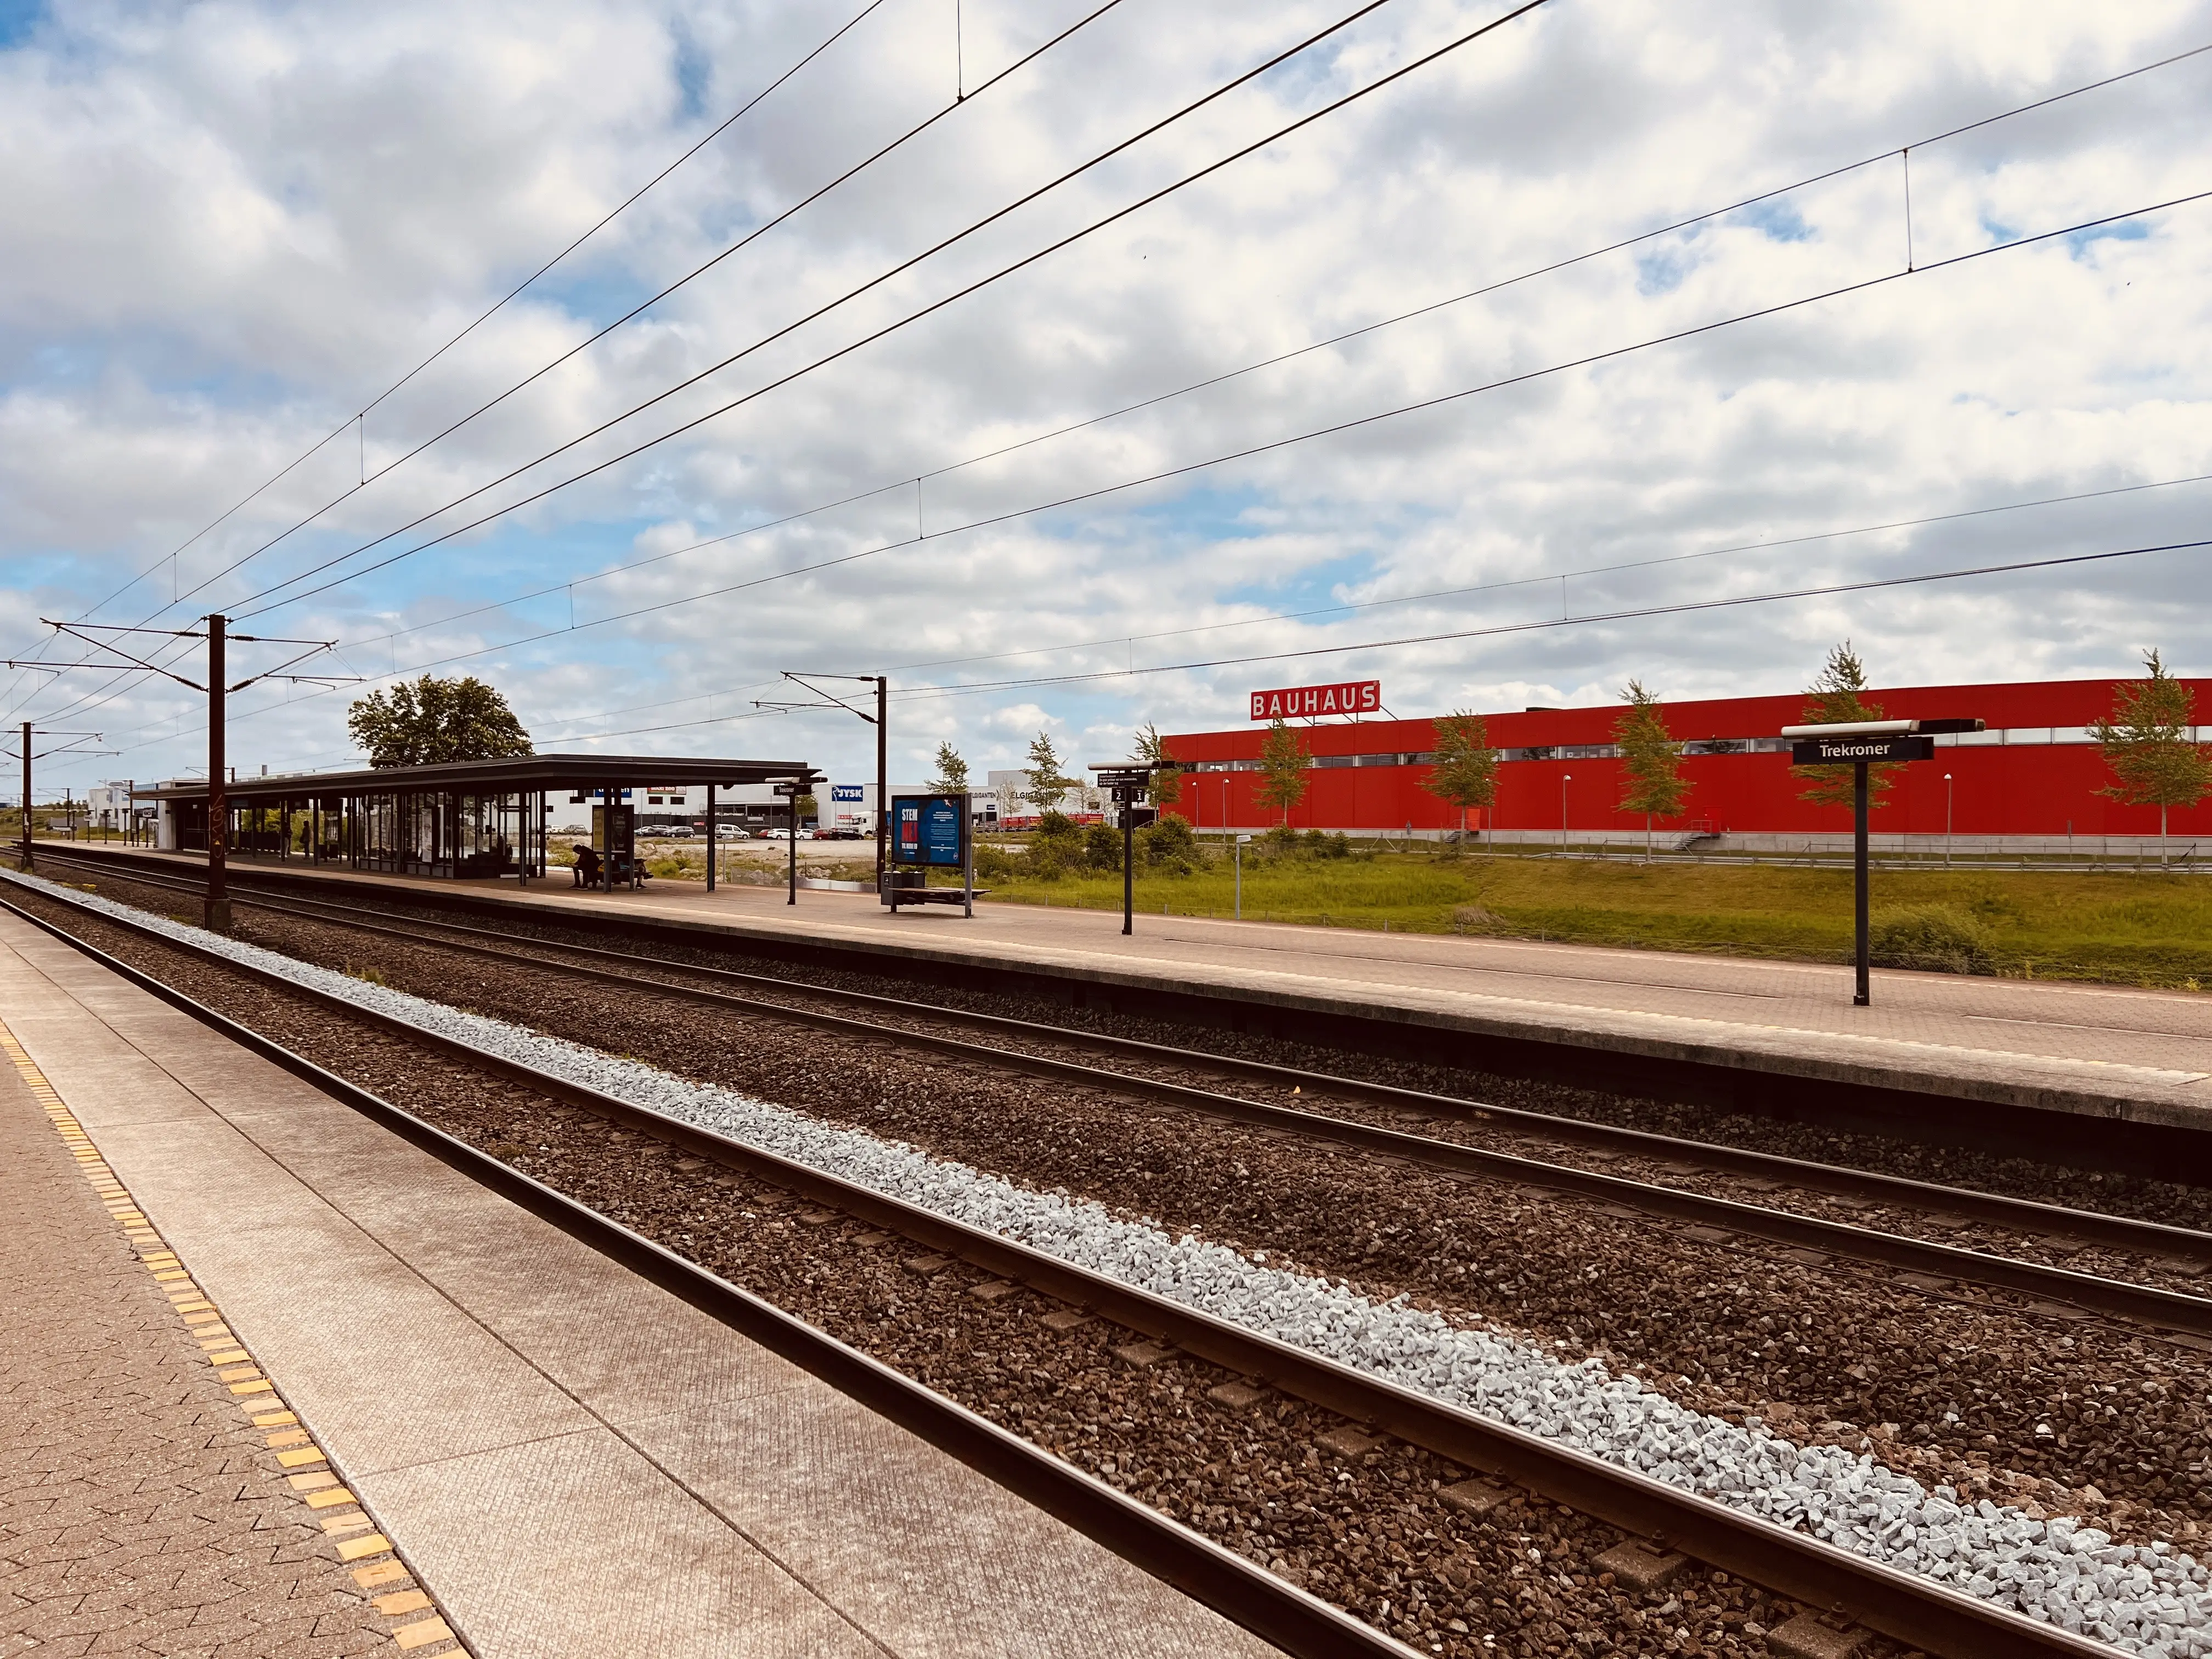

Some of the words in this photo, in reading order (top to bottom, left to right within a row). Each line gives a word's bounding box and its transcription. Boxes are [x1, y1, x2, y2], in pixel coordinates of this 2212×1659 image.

[1253, 686, 1375, 716] BAUHAUS
[1820, 744, 1891, 757] Trekroner
[838, 789, 862, 798] JYSK
[902, 809, 918, 821] STEM
